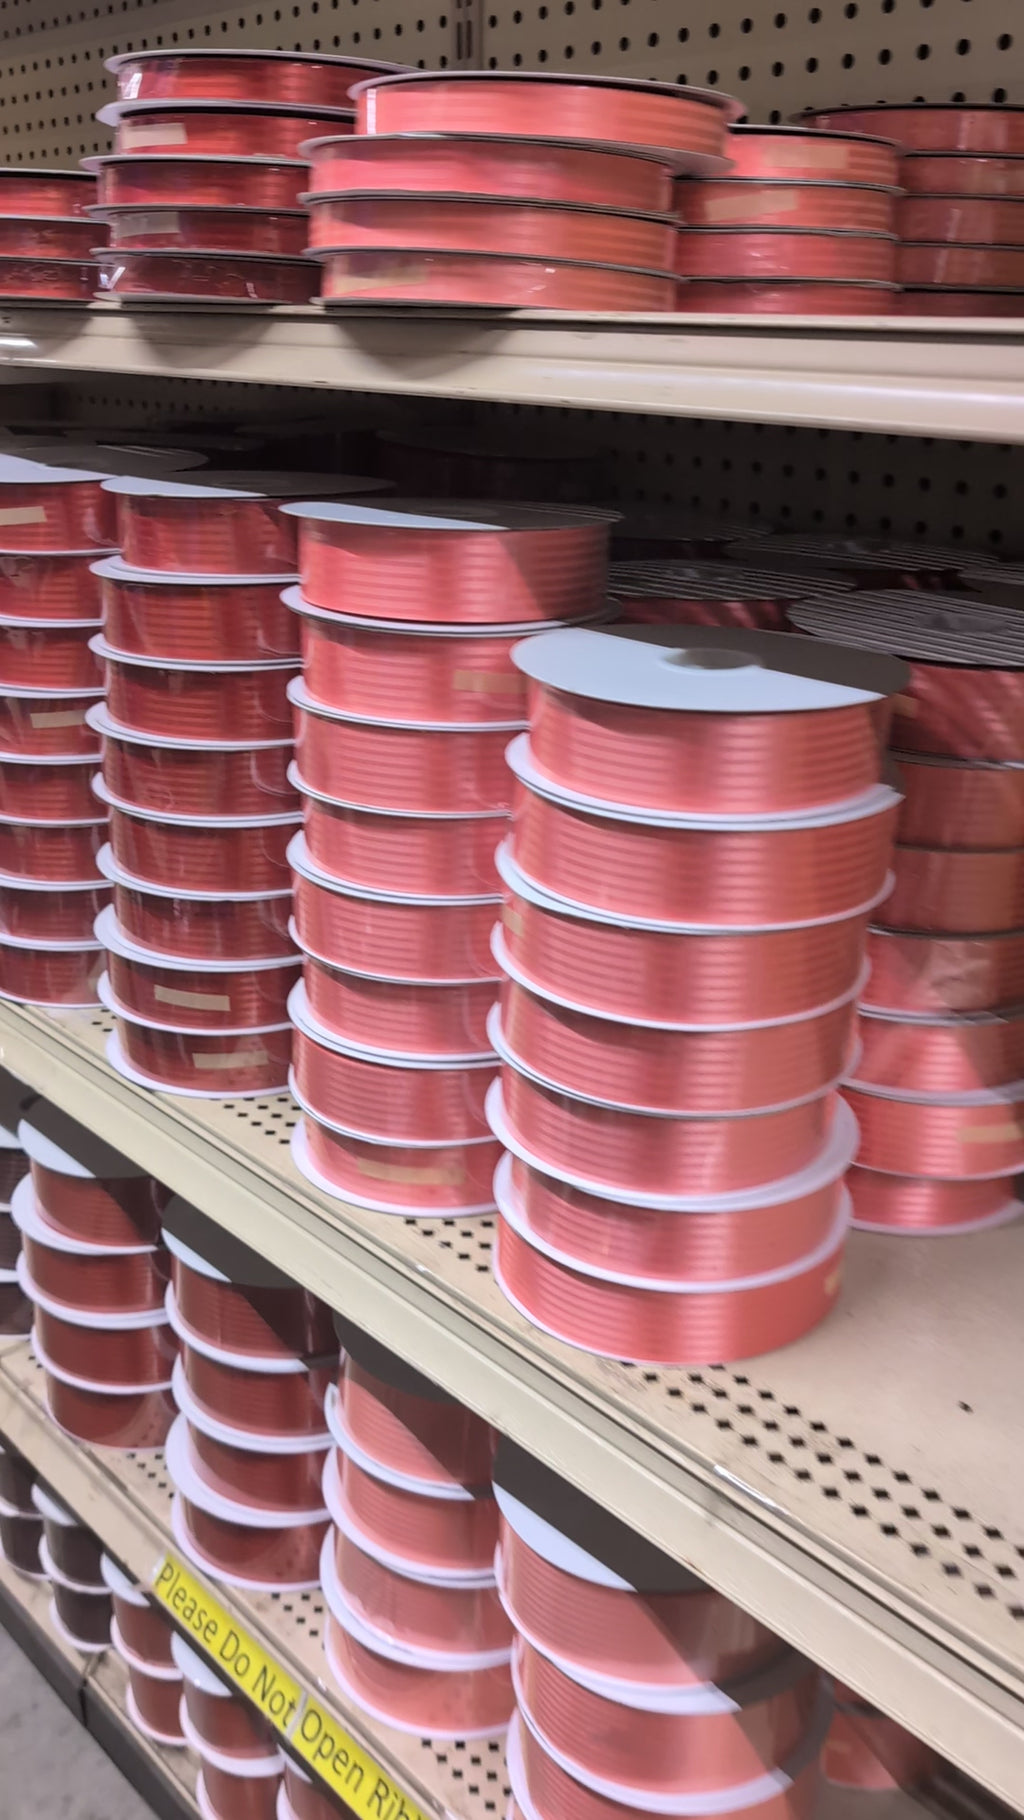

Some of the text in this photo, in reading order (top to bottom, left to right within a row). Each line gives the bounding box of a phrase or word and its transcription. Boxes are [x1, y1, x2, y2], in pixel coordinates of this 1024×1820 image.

[155, 1562, 219, 1643] Please
[219, 1630, 250, 1677] Do
[252, 1664, 297, 1728] Not
[300, 1709, 365, 1793] Open
